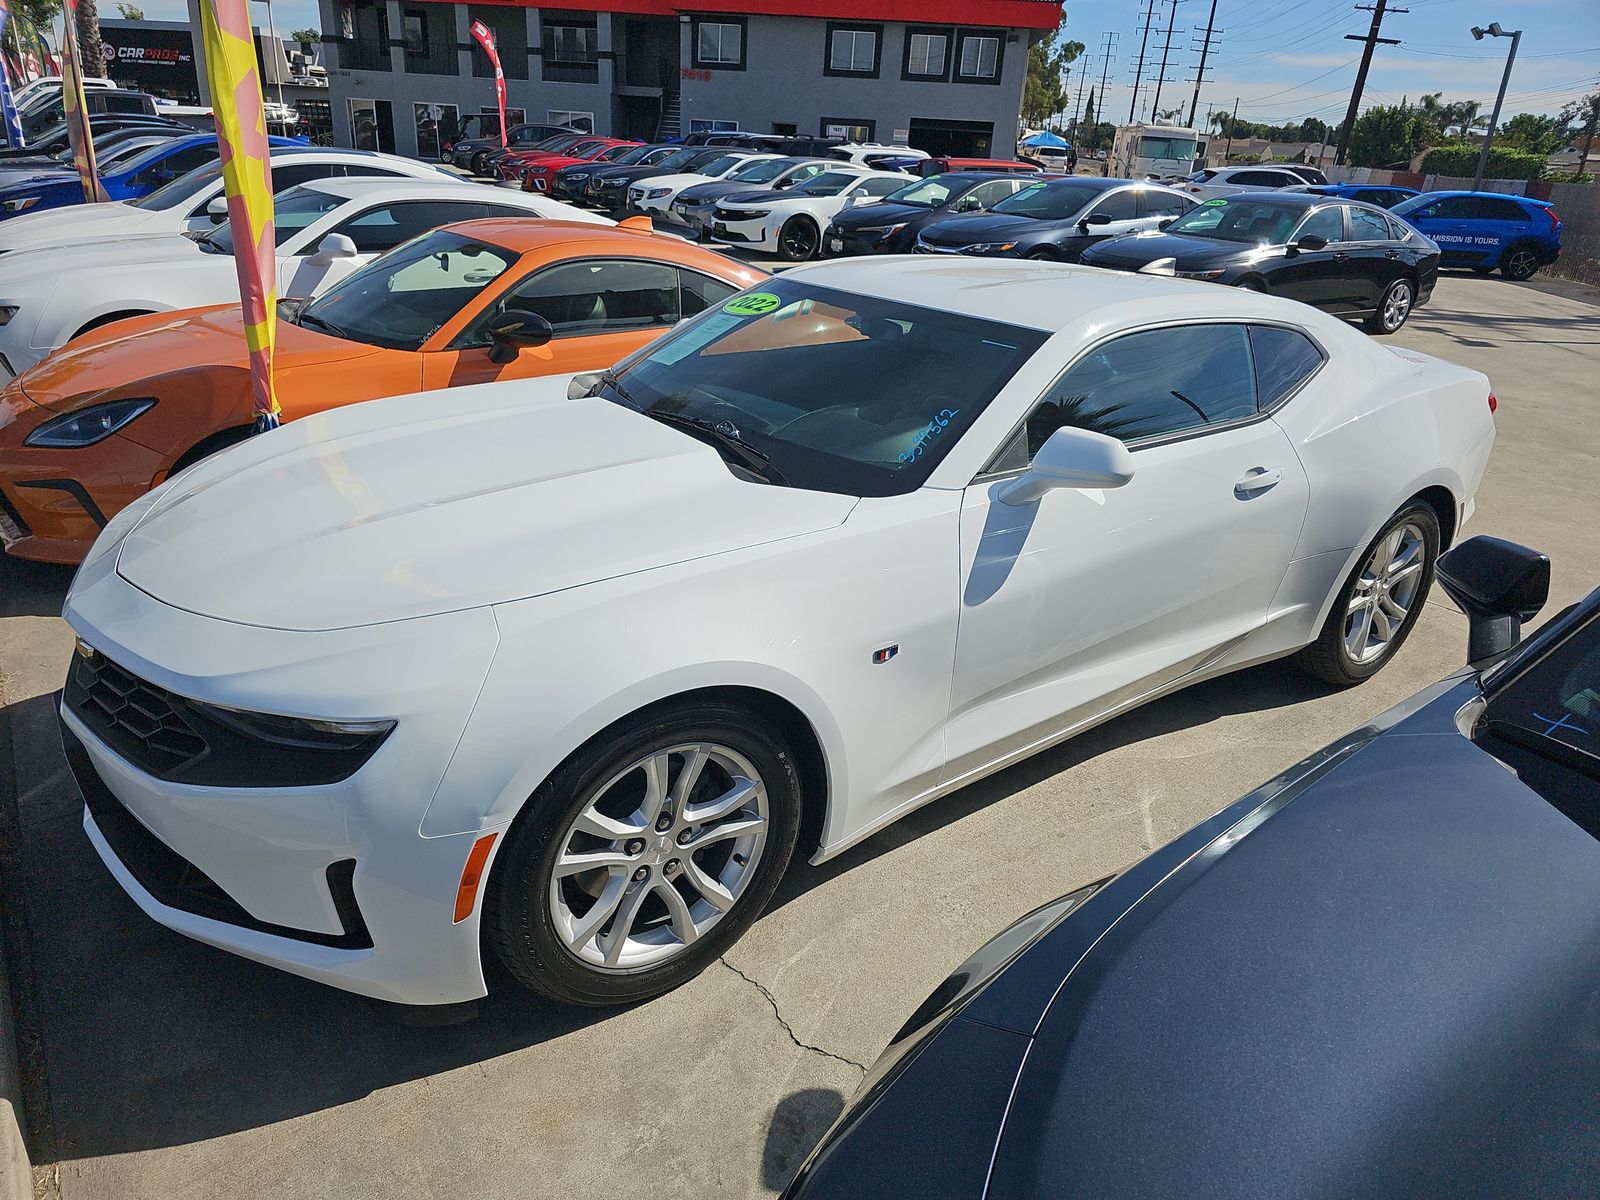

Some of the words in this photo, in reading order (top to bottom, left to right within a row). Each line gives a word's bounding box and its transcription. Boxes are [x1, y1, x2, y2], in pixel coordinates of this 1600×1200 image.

[1432, 233, 1464, 243] MISSION
[1464, 236, 1473, 244] IS
[1474, 236, 1500, 246] YOURS.
[727, 296, 778, 312] 2022
